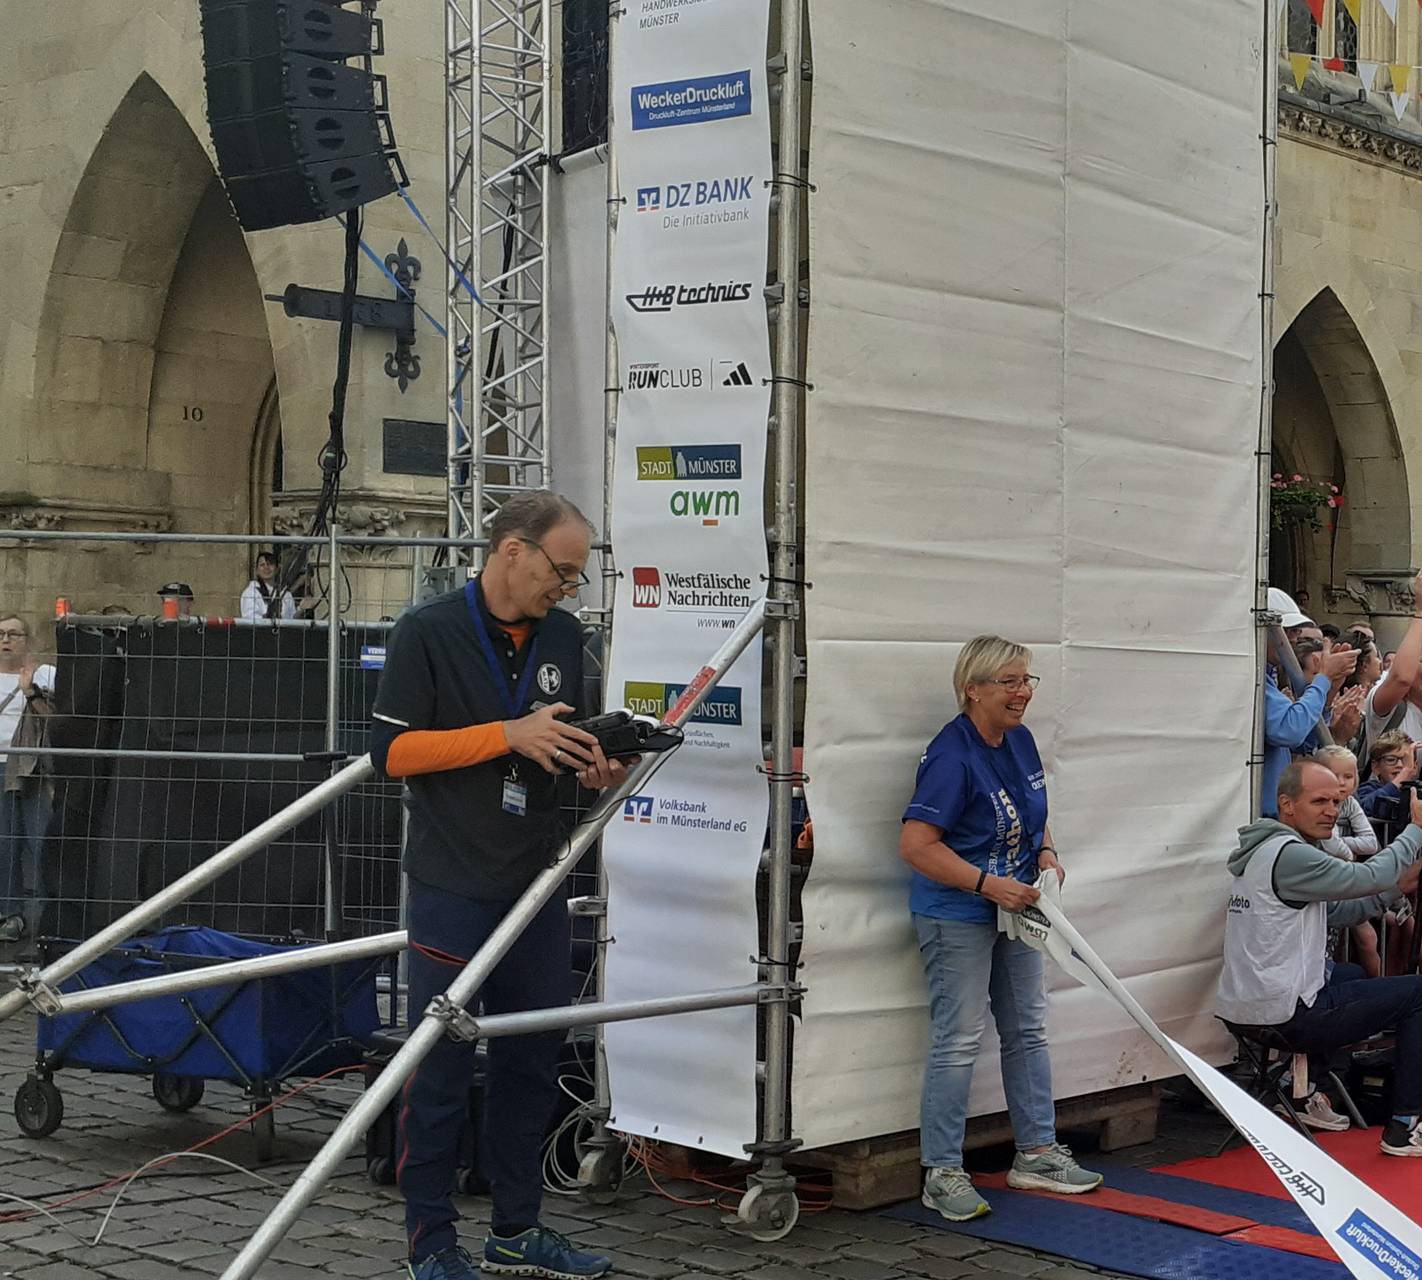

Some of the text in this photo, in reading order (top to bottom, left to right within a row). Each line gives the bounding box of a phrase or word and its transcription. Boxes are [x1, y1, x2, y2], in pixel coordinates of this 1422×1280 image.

[639, 12, 680, 29] MÜNSTER
[638, 80, 744, 109] WeckerDruckluft
[666, 176, 753, 208] DZ BANK
[663, 208, 749, 228] Die Initiativbank
[676, 281, 752, 305] technics
[628, 368, 702, 389] RUNCLUB
[183, 406, 203, 422] 10
[641, 457, 737, 475] STADT MÜNSTER
[670, 490, 740, 516] awm
[665, 573, 750, 590] Westfälische
[635, 585, 660, 605] WN
[667, 591, 750, 608] Nachrichten
[697, 618, 736, 629] www.wn
[628, 698, 737, 719] STADT NSTER
[659, 798, 707, 813] Volksbank
[656, 815, 747, 832] im Münsterland eG
